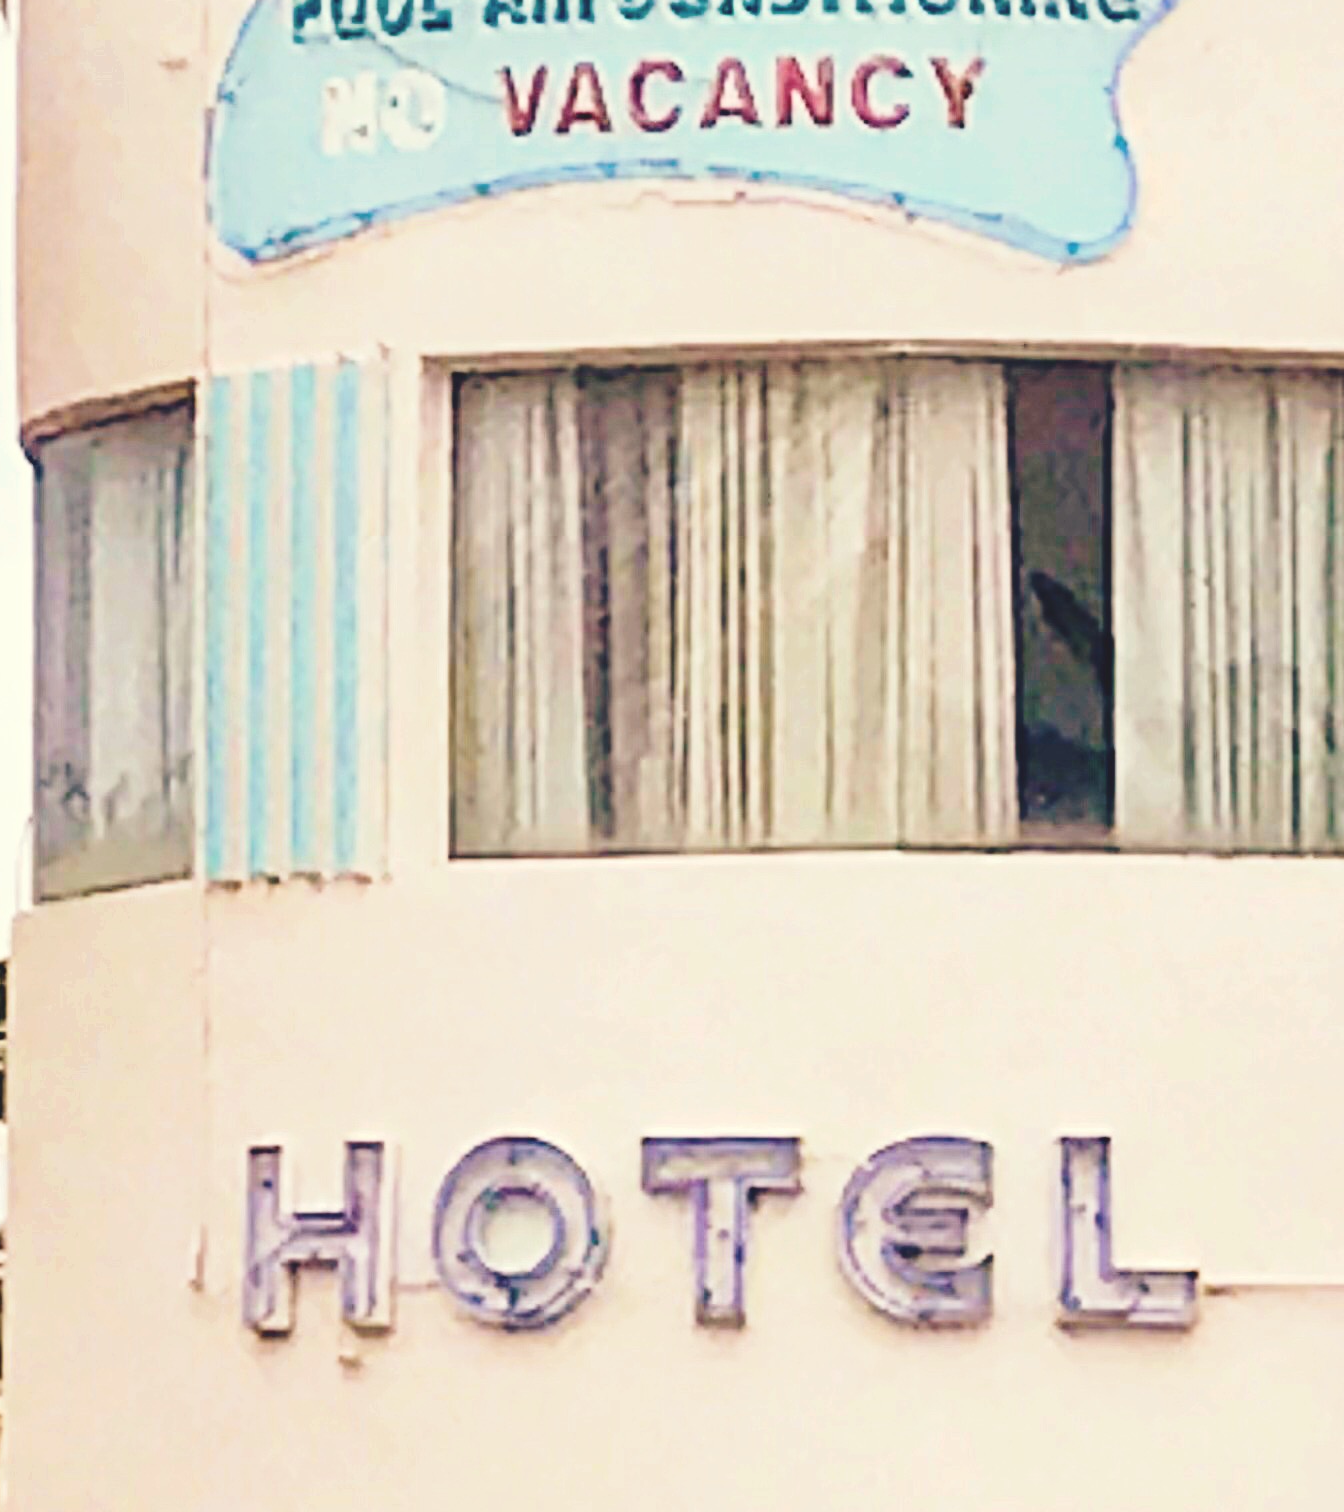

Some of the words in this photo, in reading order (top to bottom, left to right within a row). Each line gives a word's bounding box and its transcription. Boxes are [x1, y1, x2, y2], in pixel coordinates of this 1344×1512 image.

[321, 69, 446, 156] NO
[497, 54, 986, 137] VACANCY
[242, 1134, 1200, 1337] HOTEL
